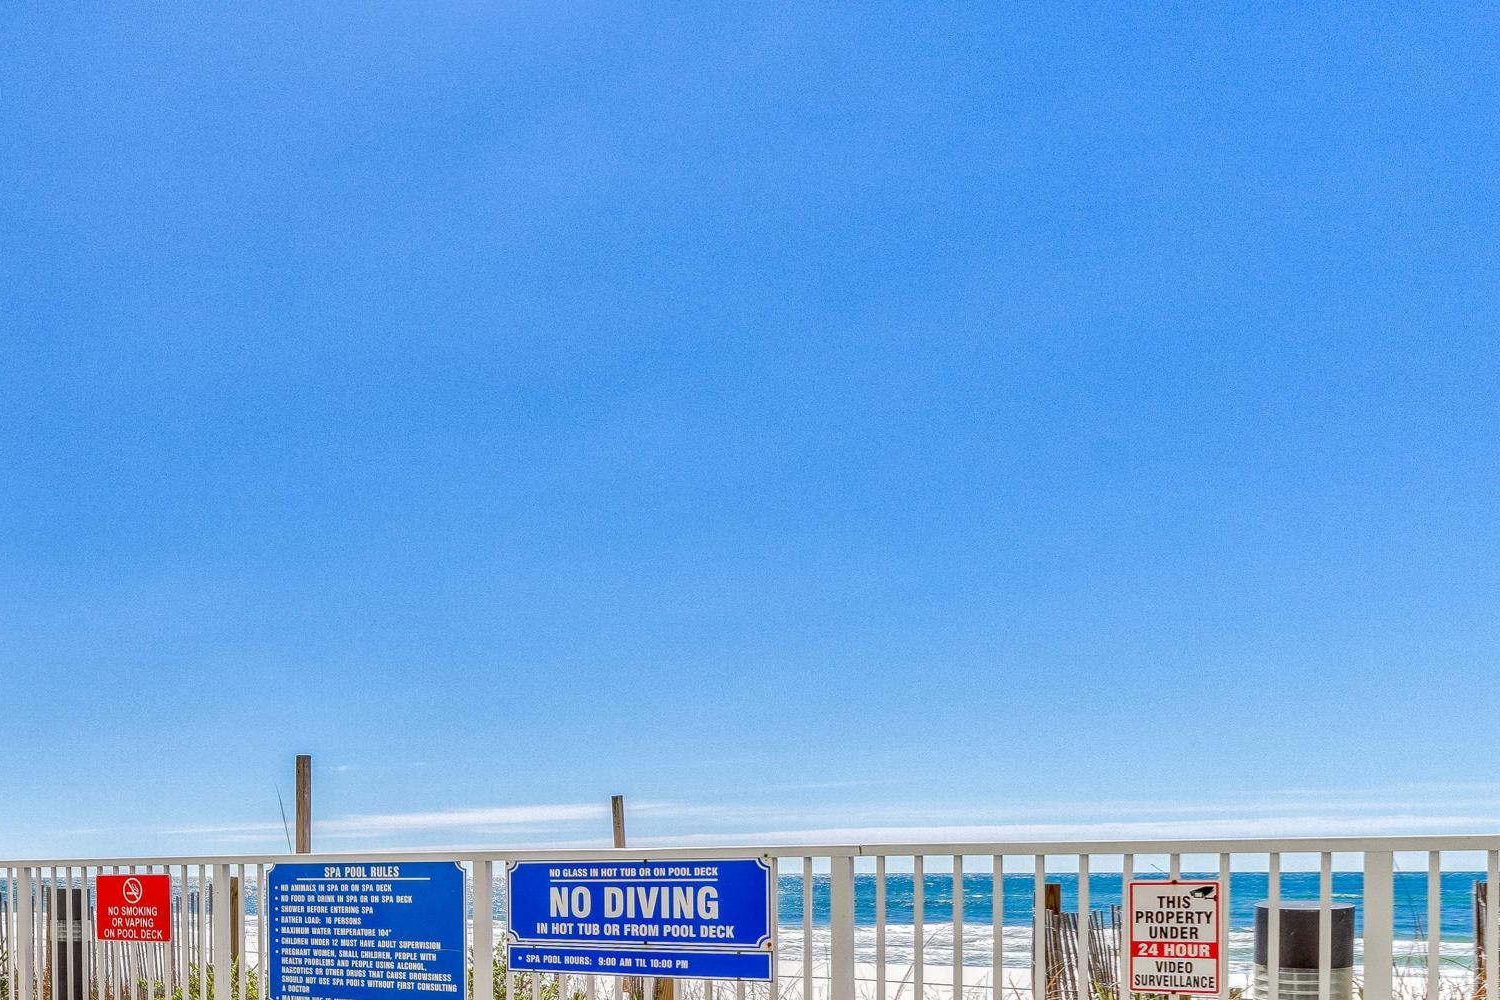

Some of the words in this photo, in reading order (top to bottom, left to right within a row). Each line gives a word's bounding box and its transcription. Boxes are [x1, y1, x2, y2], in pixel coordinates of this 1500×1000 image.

[324, 866, 341, 878] SPA
[345, 866, 366, 878] POOL
[370, 866, 400, 877] RULES
[550, 868, 560, 877] NO
[562, 868, 587, 877] GLASS
[590, 868, 598, 876] IN
[601, 868, 617, 876] HOT
[620, 868, 636, 876] TUB
[639, 868, 651, 876] OR
[654, 868, 666, 876] ON
[668, 867, 692, 876] POOL
[694, 866, 718, 876] DECK
[280, 894, 288, 902] NO
[290, 894, 306, 902] FOOD
[307, 894, 315, 902] OR
[318, 894, 335, 902] DRINK
[360, 895, 368, 903] OR
[396, 896, 412, 904] DECK
[550, 886, 592, 918] NO
[604, 886, 719, 920] DIVING
[1157, 896, 1191, 908] THIS
[108, 906, 119, 916] NO
[122, 906, 158, 916] SMOKING
[330, 906, 360, 914] ENTERING
[362, 906, 374, 914] SPA
[112, 918, 122, 926] OR
[124, 918, 154, 928] VAPING
[1135, 911, 1213, 924] PROPERTY
[104, 928, 114, 938] ON
[118, 929, 138, 938] POOL
[140, 930, 162, 939] DECK
[334, 928, 376, 936] TEMPERATURE
[536, 922, 548, 934] IN
[552, 922, 574, 936] HOT
[577, 923, 600, 936] TUB
[604, 924, 620, 936] OR
[624, 924, 658, 937] FROM
[663, 924, 696, 938] POOL
[700, 926, 734, 938] DECK
[1149, 926, 1198, 940] UNDER
[340, 938, 357, 946] MUST
[360, 940, 375, 948] HAVE
[378, 940, 396, 948] ADULT
[398, 941, 440, 950] SUPERVISION
[1138, 943, 1158, 956] 24
[1164, 944, 1210, 957] HOUR
[282, 948, 310, 956] PREGNANT
[394, 952, 417, 960] PEOPLE
[420, 953, 436, 962] WITH
[304, 958, 334, 966] PROBLEMS
[336, 959, 350, 967] AND
[352, 960, 374, 968] PEOPLE
[376, 962, 394, 970] USING
[526, 954, 540, 963] SPA
[543, 954, 562, 964] POOL
[564, 956, 592, 965] HOURS:
[598, 957, 616, 966] 9:00
[619, 958, 632, 967] AM
[634, 958, 647, 968] TIL
[650, 958, 672, 968] 10:00
[676, 960, 688, 969] PM
[1156, 961, 1193, 974] VIDEO
[346, 970, 366, 978] DRUGS
[369, 970, 384, 978] THAT
[386, 972, 406, 980] CAUSE
[409, 972, 452, 982] DROWSINESS
[1134, 974, 1214, 988] SURVEILLANCE
[282, 975, 304, 984] SHOULD
[332, 978, 344, 986] SPA
[367, 980, 394, 988] WITHOUT
[397, 982, 414, 990] FIRST
[417, 982, 458, 992] CONSULTING
[288, 985, 310, 993] DOCTOR
